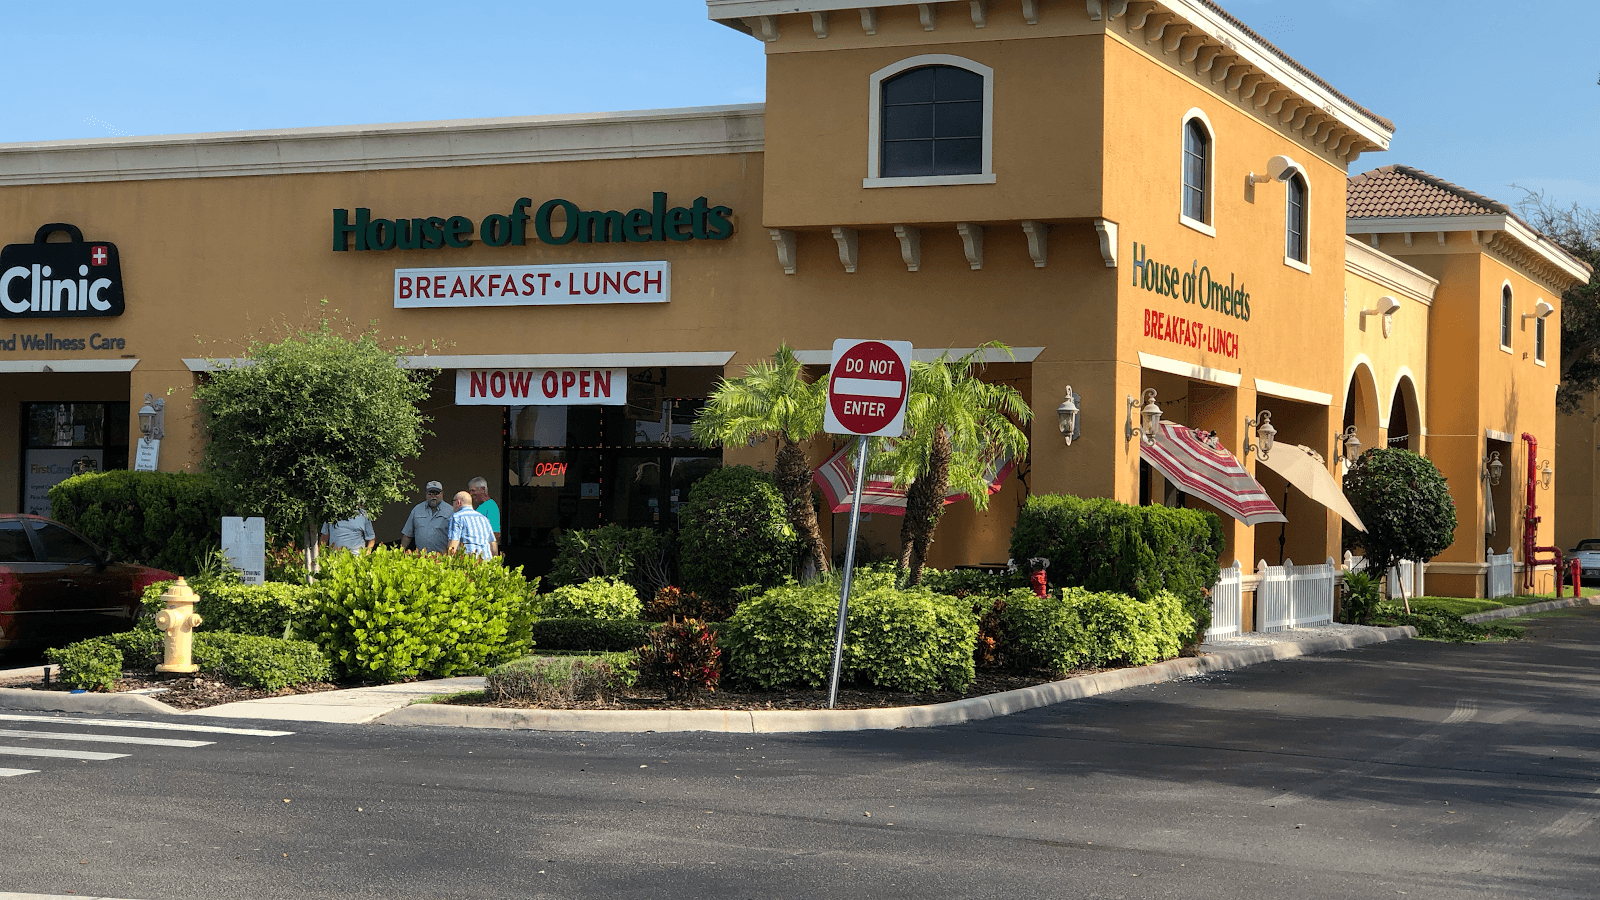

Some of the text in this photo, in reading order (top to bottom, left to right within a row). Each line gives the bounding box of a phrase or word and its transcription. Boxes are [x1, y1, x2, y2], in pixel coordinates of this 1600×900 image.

[332, 191, 734, 252] House of Omelets
[0, 264, 112, 313] Clinic
[399, 270, 663, 299] BREAKFAST LUNCH
[1132, 241, 1250, 322] House of Omelets
[20, 333, 86, 350] Wellness
[89, 333, 125, 350] Care
[1144, 308, 1239, 360] BREAKFAST LUNCH
[845, 357, 895, 374] DO NOT
[470, 370, 612, 399] NOW OPEN
[843, 400, 886, 417] ENTER
[660, 432, 670, 443] 26
[535, 462, 568, 476] OPEN
